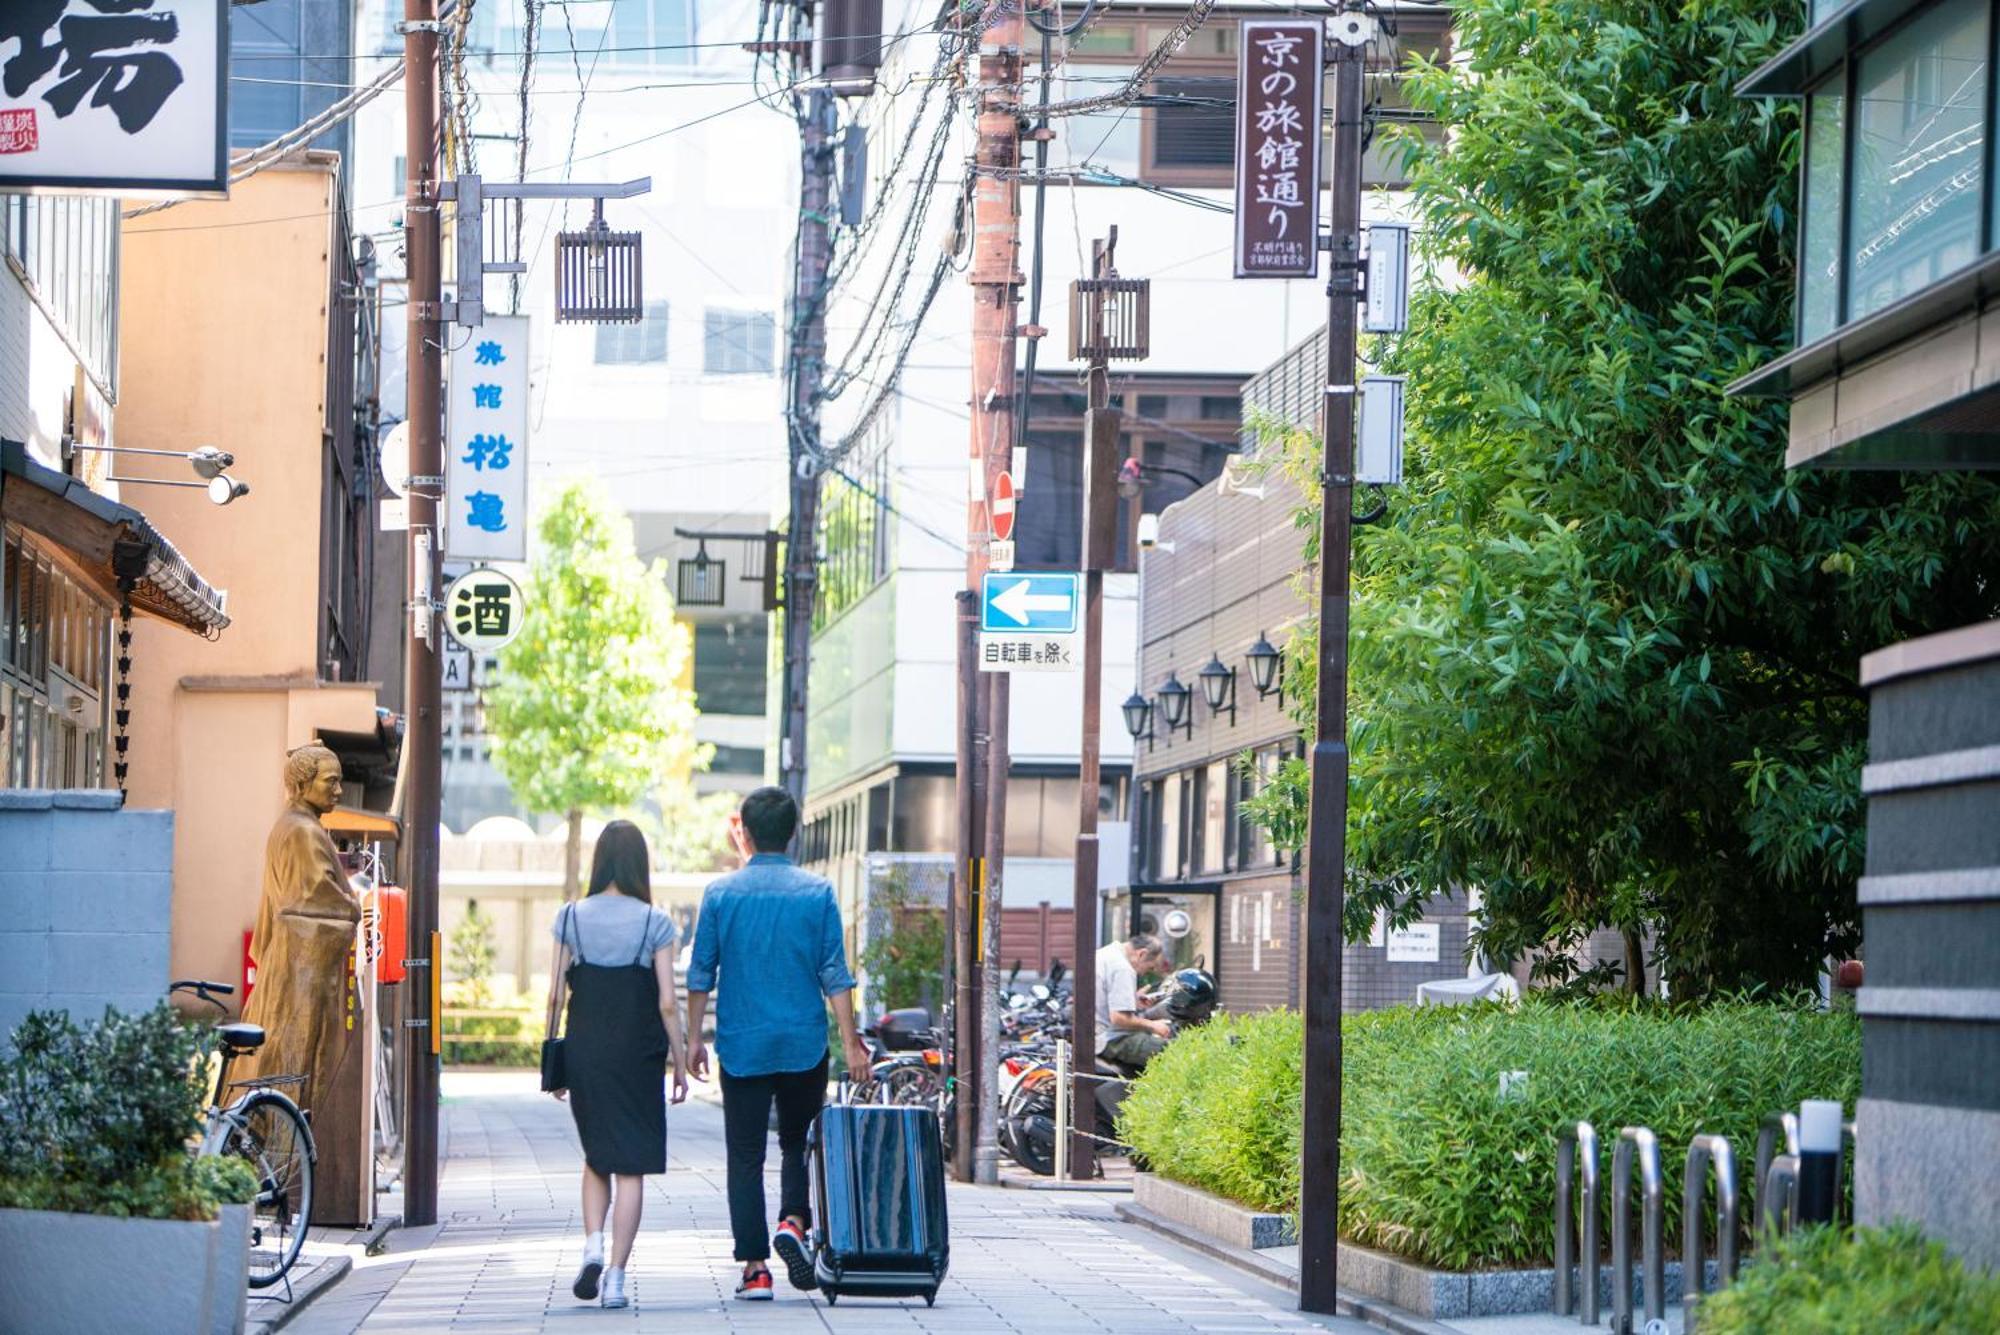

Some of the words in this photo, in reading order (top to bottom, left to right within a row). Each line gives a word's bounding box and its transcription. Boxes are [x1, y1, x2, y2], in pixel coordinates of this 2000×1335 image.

[1255, 32, 1304, 239] 京の旅館通り
[455, 584, 511, 636] 酒
[985, 642, 1070, 664] 自転車を除く
